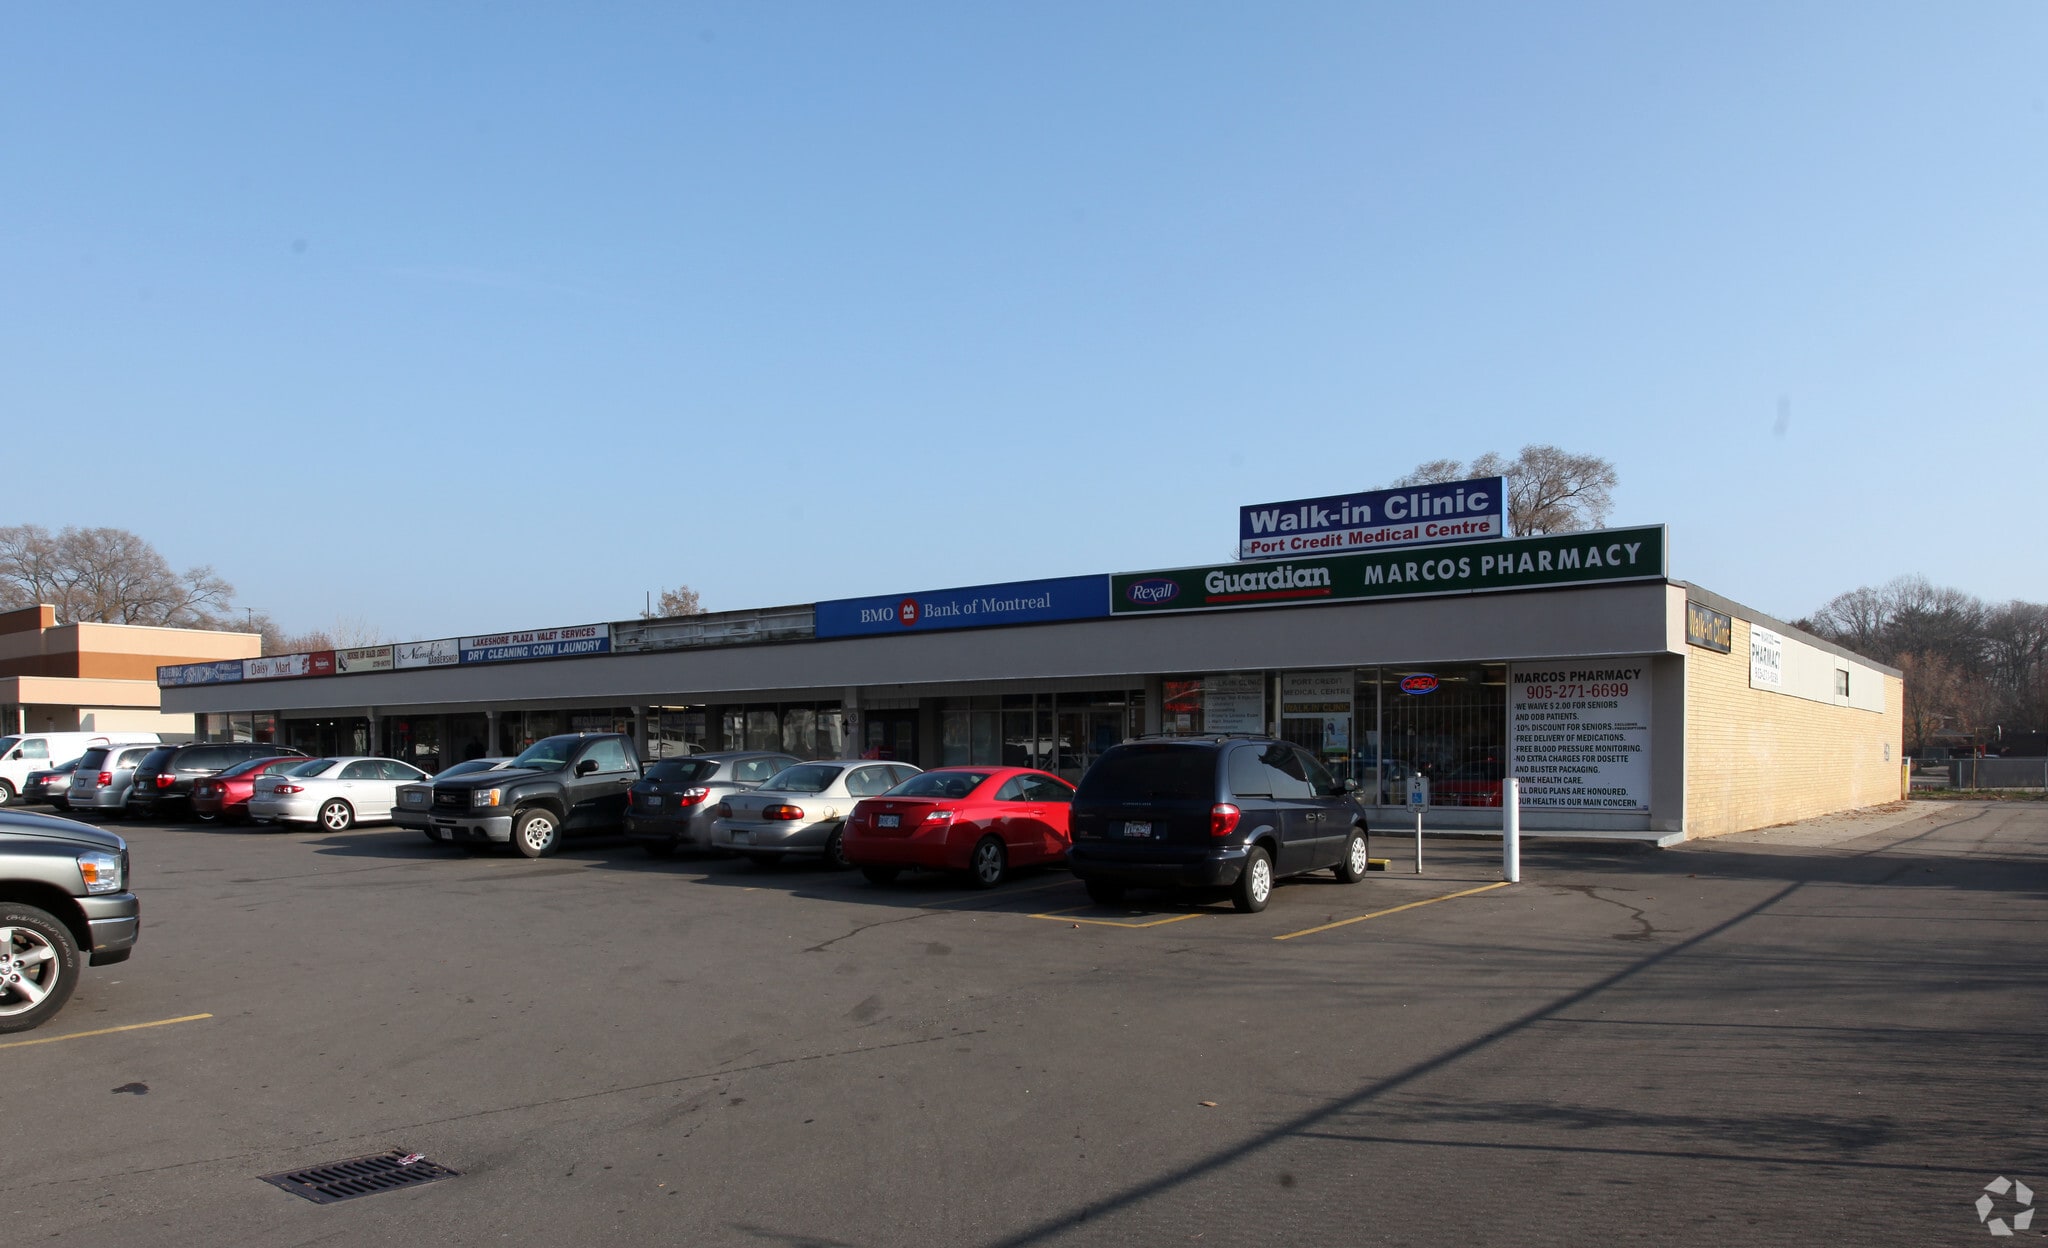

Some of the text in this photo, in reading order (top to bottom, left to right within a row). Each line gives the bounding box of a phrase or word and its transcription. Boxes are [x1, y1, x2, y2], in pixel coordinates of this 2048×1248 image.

[1250, 489, 1490, 534] Walk-in Clinic
[1250, 518, 1491, 554] Port Credit Medical Centre
[1364, 541, 1642, 586] MARCOS PHARMACY
[1204, 564, 1331, 594] Guardian
[1133, 582, 1172, 601] Rexall
[860, 593, 1051, 623] BMO Bank of Montreal
[472, 626, 596, 648] LAKESHORE PLAZA VALET SERVICES
[468, 650, 484, 661] DRY
[558, 640, 601, 654] LAUNDRY
[251, 662, 268, 676] Daisy
[275, 661, 292, 674] Mart
[1514, 669, 1642, 683] MARCOS PHARMACY
[1402, 677, 1438, 690] OPEN
[1284, 688, 1318, 696] MEDICAL
[1526, 683, 1628, 699] 905-271-6699
[1528, 702, 1548, 710] WAIVE
[1550, 702, 1554, 710] $
[1555, 702, 1571, 710] 2.00
[1546, 712, 1580, 720] PATIENTS.
[1532, 723, 1566, 731] DISCOUNT
[1534, 734, 1564, 742] DELIVERY
[1566, 734, 1575, 742] OF
[1596, 744, 1642, 752] MONITORING.
[1558, 766, 1600, 774] PACKAGING.
[1538, 776, 1562, 784] HEALTH
[1563, 776, 1584, 784] CARE.
[1549, 787, 1571, 795] PLANS
[1572, 787, 1586, 795] ARE
[1587, 788, 1628, 796] HONOURED.
[1532, 797, 1558, 805] HEALTH
[1567, 798, 1582, 806] OUR
[1583, 798, 1601, 806] MAIN
[1602, 798, 1637, 806] CONCERN
